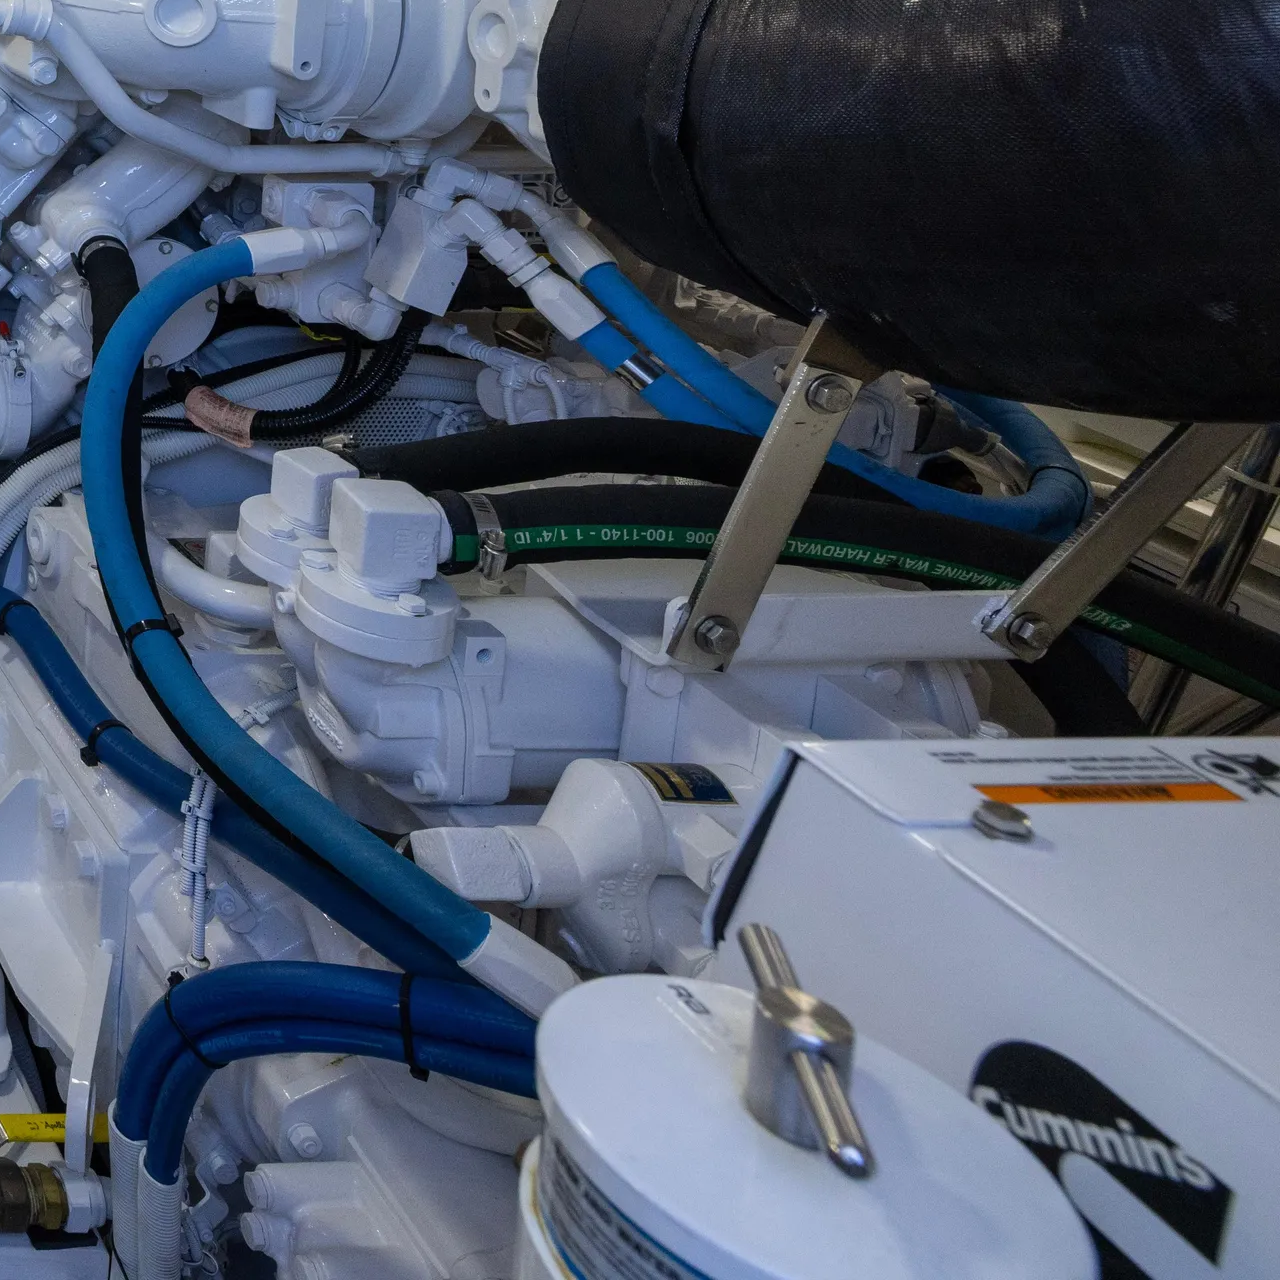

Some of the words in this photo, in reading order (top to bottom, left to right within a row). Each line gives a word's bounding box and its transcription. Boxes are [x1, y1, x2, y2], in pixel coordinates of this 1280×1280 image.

[514, 531, 531, 544] ID
[537, 528, 568, 544] 1/4"
[601, 528, 675, 542] 100-1140
[685, 531, 717, 545] 006
[784, 539, 871, 565] HARDWAL
[873, 550, 931, 574] WATER
[933, 561, 997, 589] MARINE
[972, 1085, 1215, 1190] Cummins
